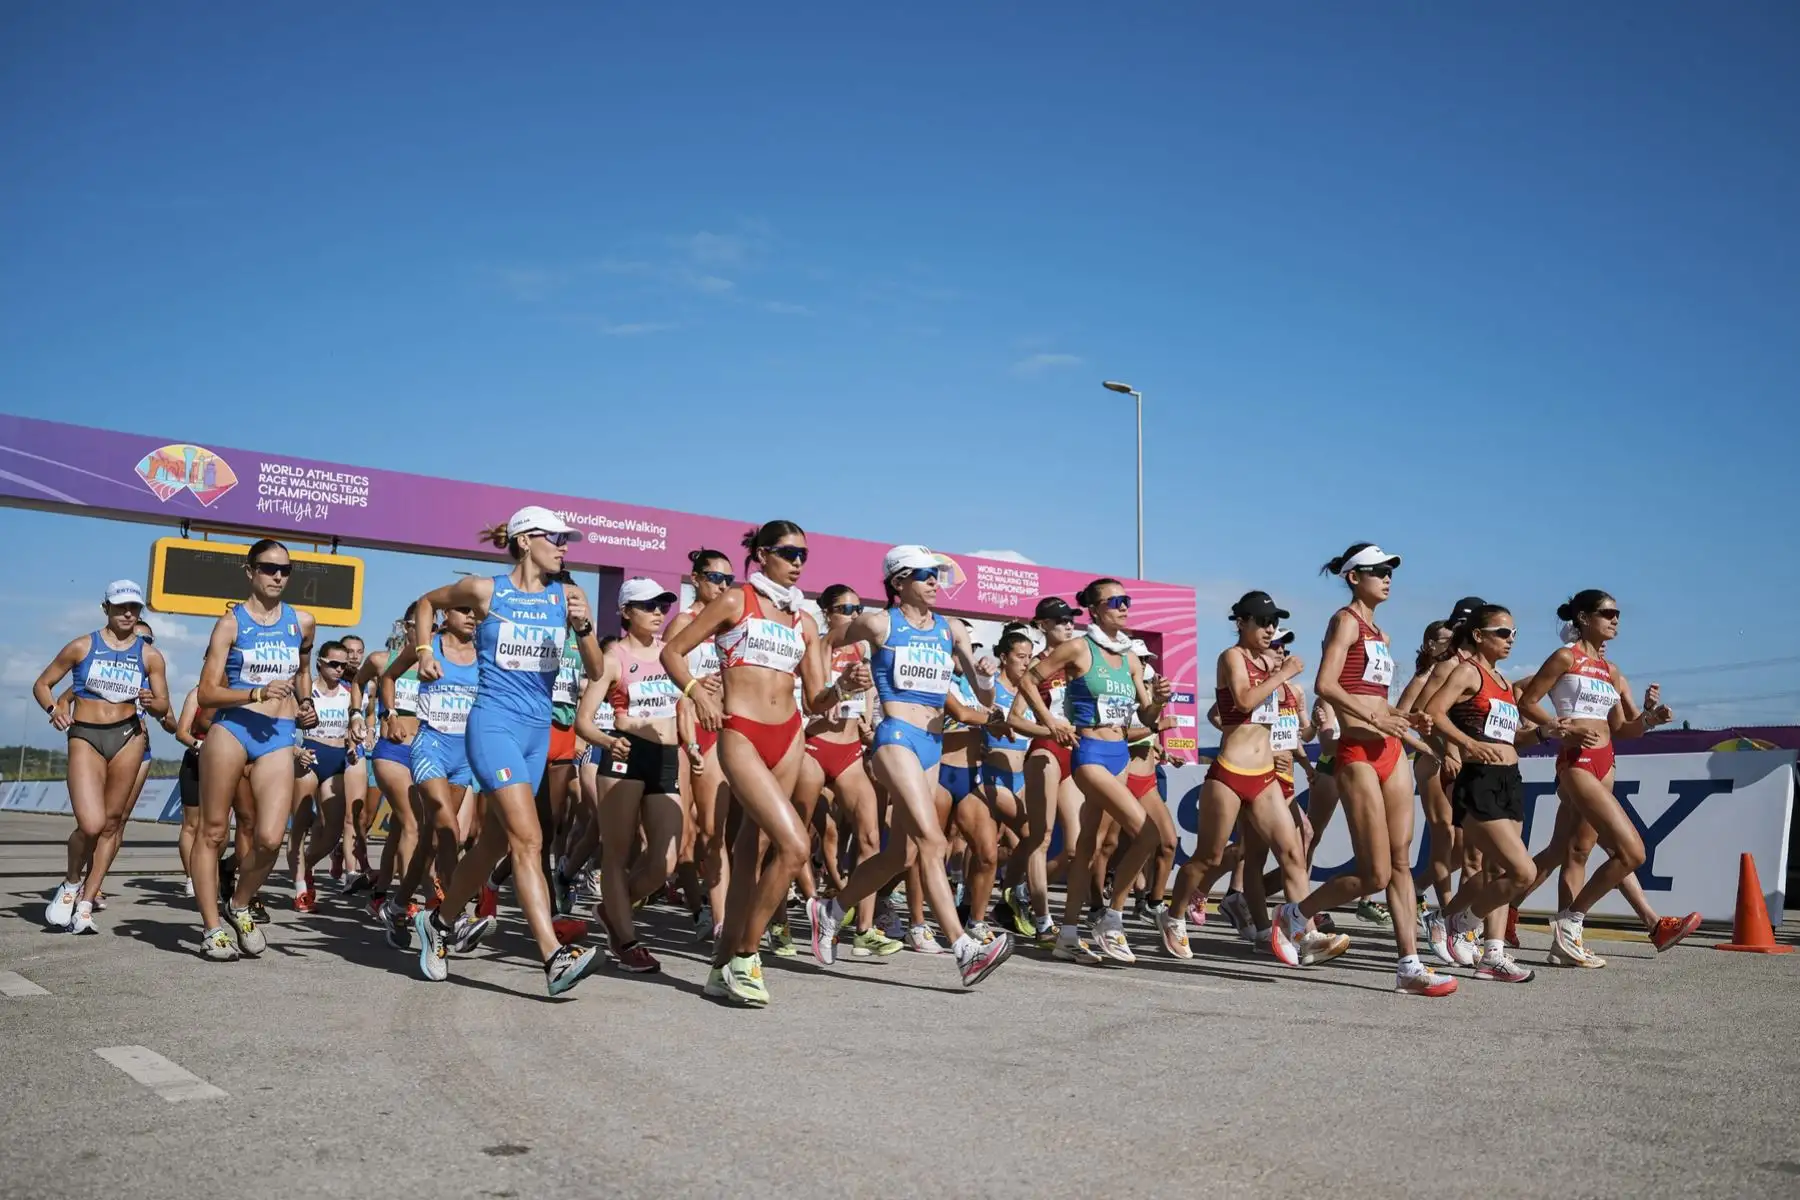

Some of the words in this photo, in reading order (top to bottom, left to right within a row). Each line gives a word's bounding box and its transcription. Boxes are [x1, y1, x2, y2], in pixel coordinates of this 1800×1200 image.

[260, 462, 304, 477] WORLD
[306, 468, 369, 486] ATHLETICS
[258, 473, 288, 486] RACE
[290, 477, 338, 492] WALKING
[340, 484, 369, 496] TEAM
[257, 483, 368, 507] CHAMPIONSHIPS
[256, 497, 312, 522] ANTALYA
[315, 503, 328, 520] 24
[588, 532, 667, 550] @waantalya24
[977, 564, 1002, 575] WORLD
[1003, 568, 1039, 580] ATHLETICS
[977, 581, 1039, 596] CHAMPIONSHIPS
[512, 611, 548, 620] ITALIA
[513, 625, 556, 643] NTN
[762, 621, 795, 643] NTN
[255, 641, 286, 650] ITALIA
[499, 642, 550, 658] CURIAZZI
[255, 648, 291, 660] NTN
[908, 650, 946, 667] NTN
[100, 667, 135, 684] NTN
[249, 663, 283, 674] MIHAI
[899, 664, 937, 680] GIORGI
[640, 681, 674, 695] NTN
[1591, 680, 1614, 694] NTN
[319, 708, 345, 718] NTN
[1167, 739, 1194, 748] SEIKO
[1273, 731, 1292, 741] PENG
